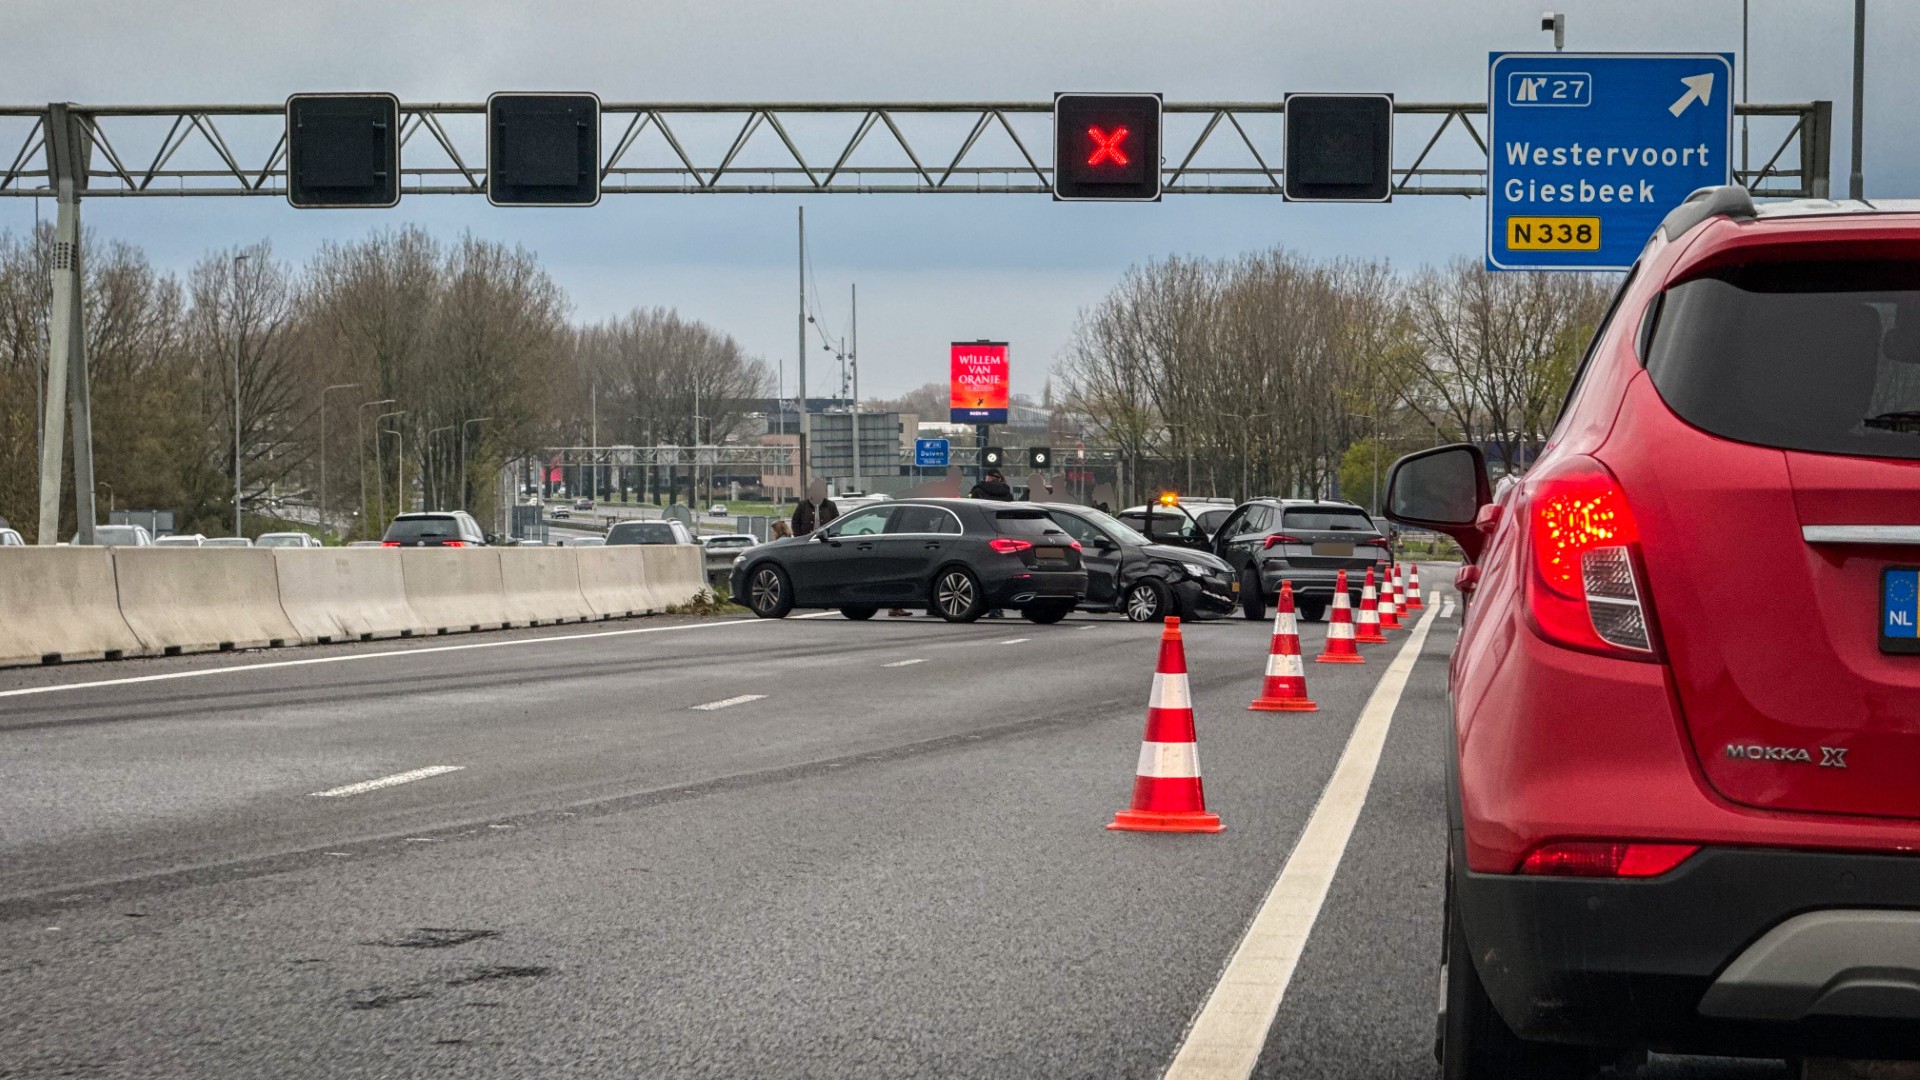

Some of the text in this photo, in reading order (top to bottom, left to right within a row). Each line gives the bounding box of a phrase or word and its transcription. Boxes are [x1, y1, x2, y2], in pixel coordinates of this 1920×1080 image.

[1552, 80, 1584, 99] 27
[1505, 142, 1709, 167] Westervoort
[1504, 178, 1655, 203] Giesbeek
[1514, 223, 1593, 244] N338
[959, 354, 1001, 365] WILLEM
[968, 365, 991, 374] VAN
[958, 374, 1000, 386] ORANJE
[1889, 610, 1912, 626] NL
[1726, 744, 1848, 768] MOKKA X
